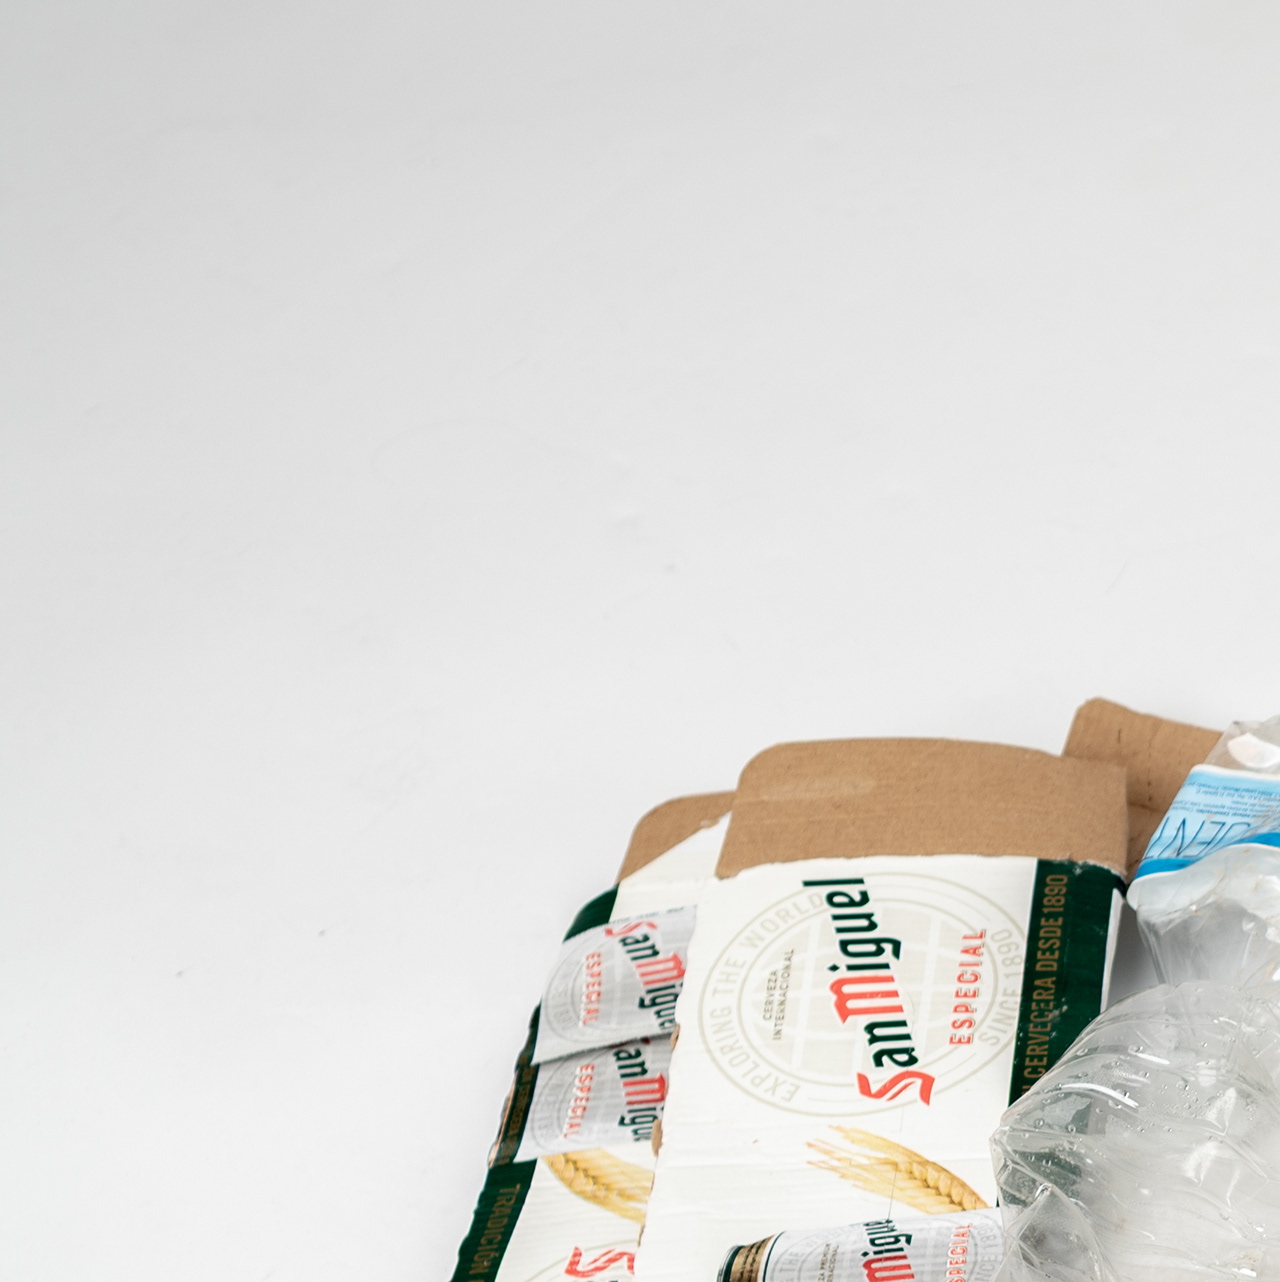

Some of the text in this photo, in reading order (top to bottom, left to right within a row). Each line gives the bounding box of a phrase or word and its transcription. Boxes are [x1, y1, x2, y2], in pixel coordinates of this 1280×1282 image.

[1044, 873, 1069, 915] 1890
[712, 955, 748, 999] THE
[1036, 916, 1064, 974] DESDE
[579, 951, 603, 1027] ESPECIAL
[761, 968, 779, 1021] CERVEZA
[771, 948, 795, 1040] INTERNACIONAL
[949, 928, 986, 1046] ESPECIAL
[979, 927, 1024, 1047] SINCE 1890
[562, 1063, 596, 1140] ESPECIAL
[475, 1182, 522, 1275] TRADICIÓN
